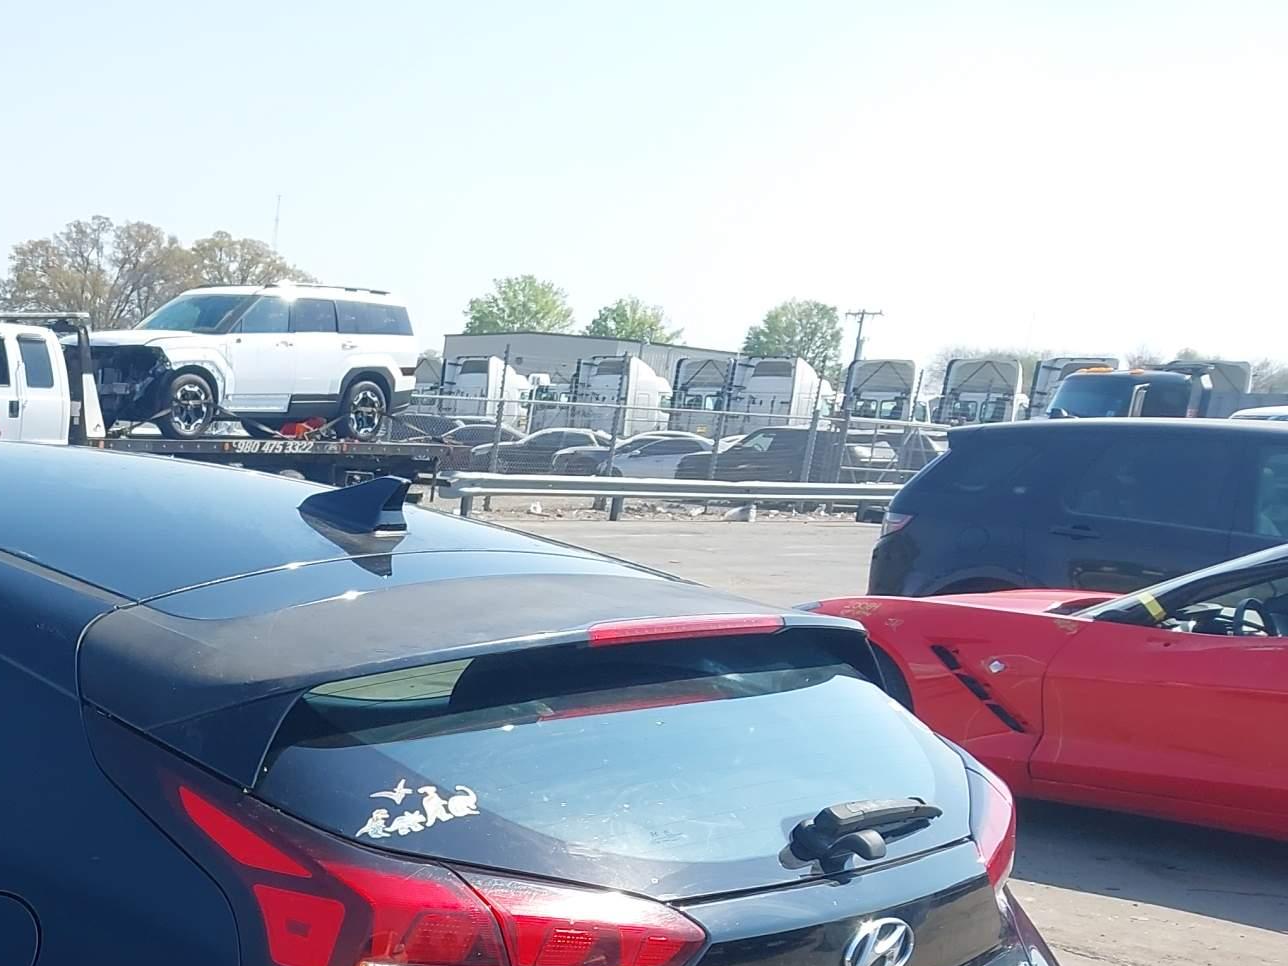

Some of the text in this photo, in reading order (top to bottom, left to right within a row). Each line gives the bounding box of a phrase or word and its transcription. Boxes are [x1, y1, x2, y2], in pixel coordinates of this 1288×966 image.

[235, 441, 313, 453] 980 475 3322
